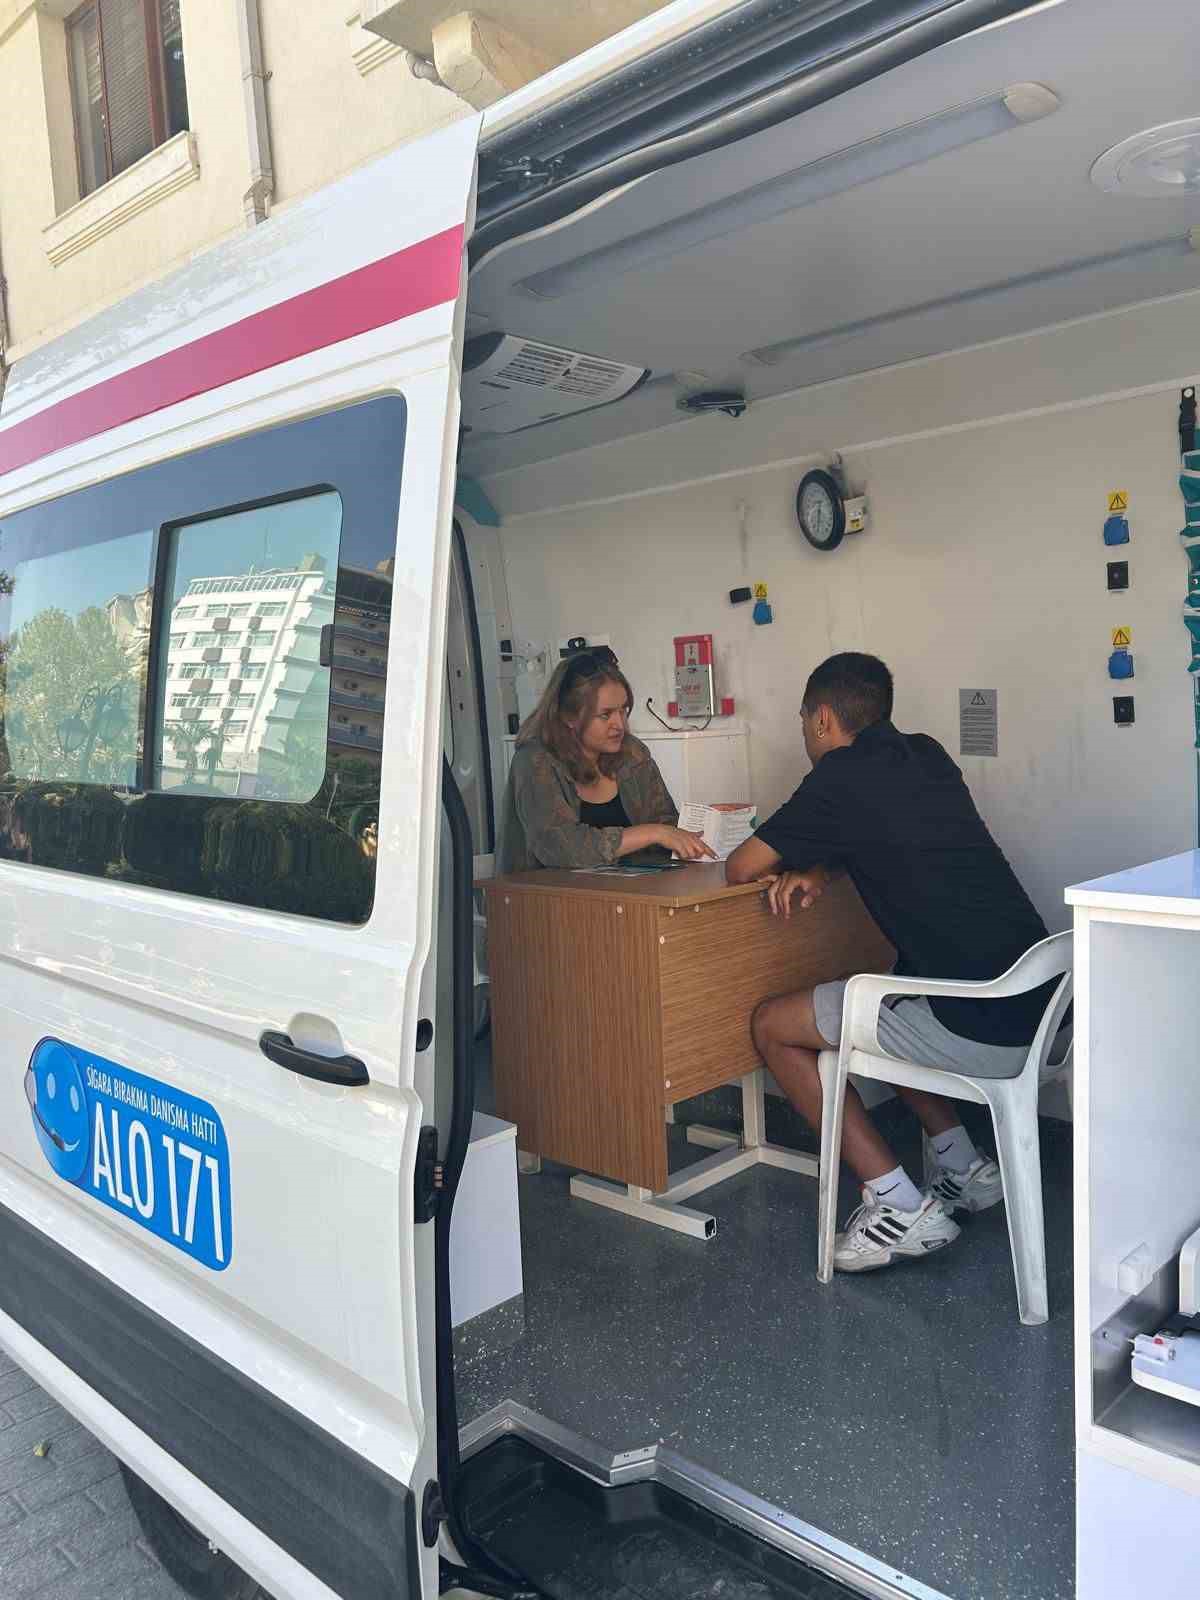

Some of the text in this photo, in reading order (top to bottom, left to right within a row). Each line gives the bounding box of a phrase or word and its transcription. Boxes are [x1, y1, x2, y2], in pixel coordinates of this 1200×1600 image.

[113, 1078, 149, 1113] BIRAKMA
[191, 1111, 217, 1146] HATTI
[93, 1101, 225, 1263] ALO 171
